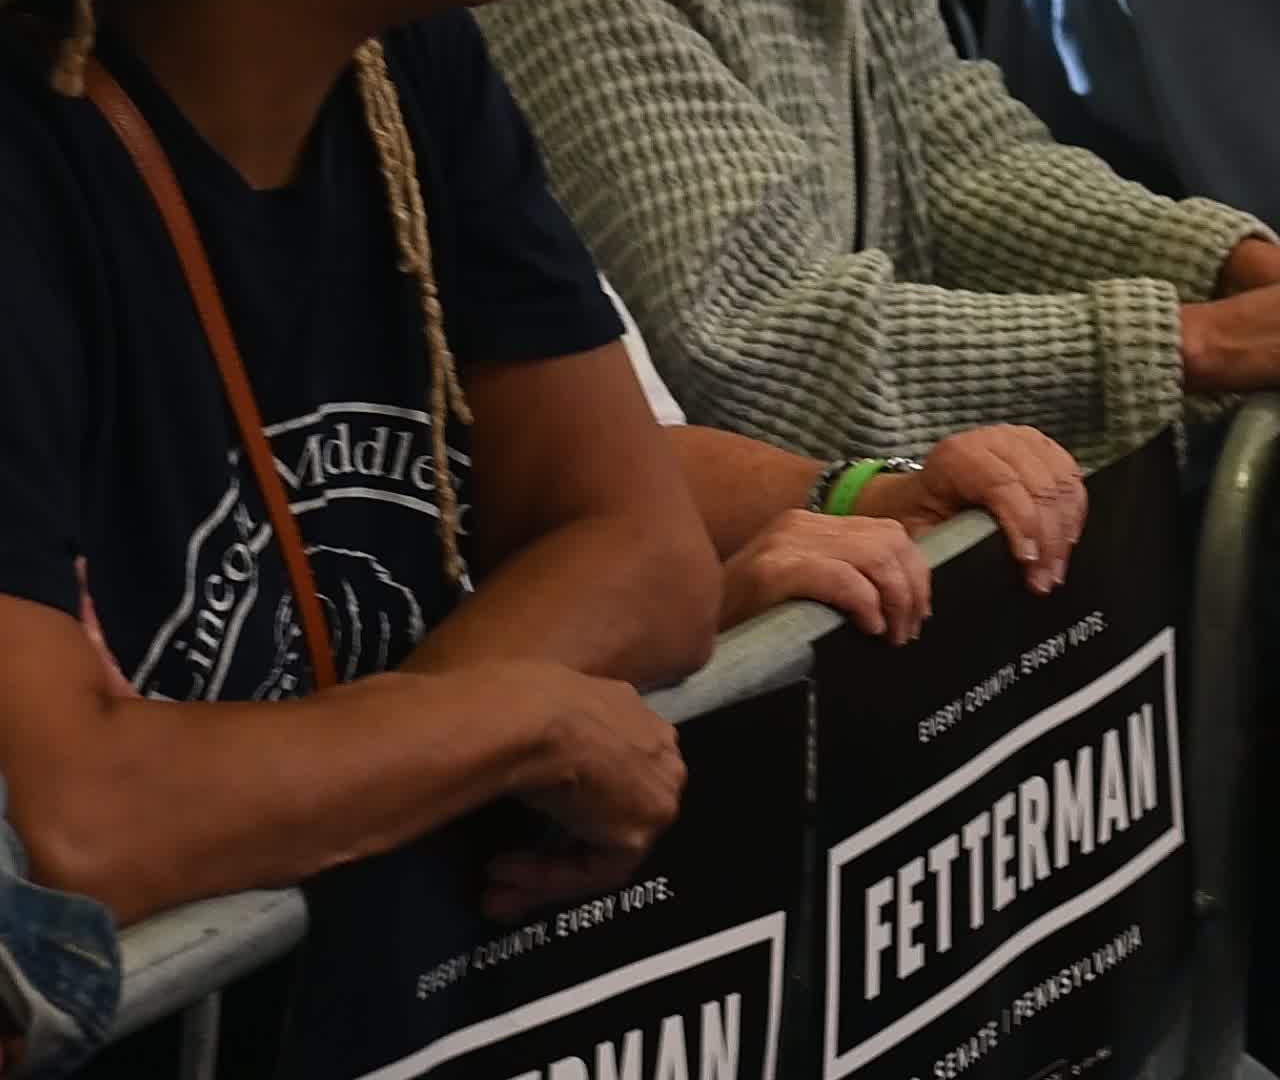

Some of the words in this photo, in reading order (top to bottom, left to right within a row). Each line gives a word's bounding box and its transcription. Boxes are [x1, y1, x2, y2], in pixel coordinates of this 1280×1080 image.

[919, 699, 963, 743] EVERY
[1020, 632, 1066, 674] EVERY
[1067, 610, 1109, 647] VOTE.
[865, 703, 1158, 1001] FETTERMAN
[416, 951, 470, 1000] EVERY
[555, 894, 617, 938] EVERY
[620, 876, 675, 913] VOTE.
[1013, 923, 1143, 1024] PENNSYLVANIA
